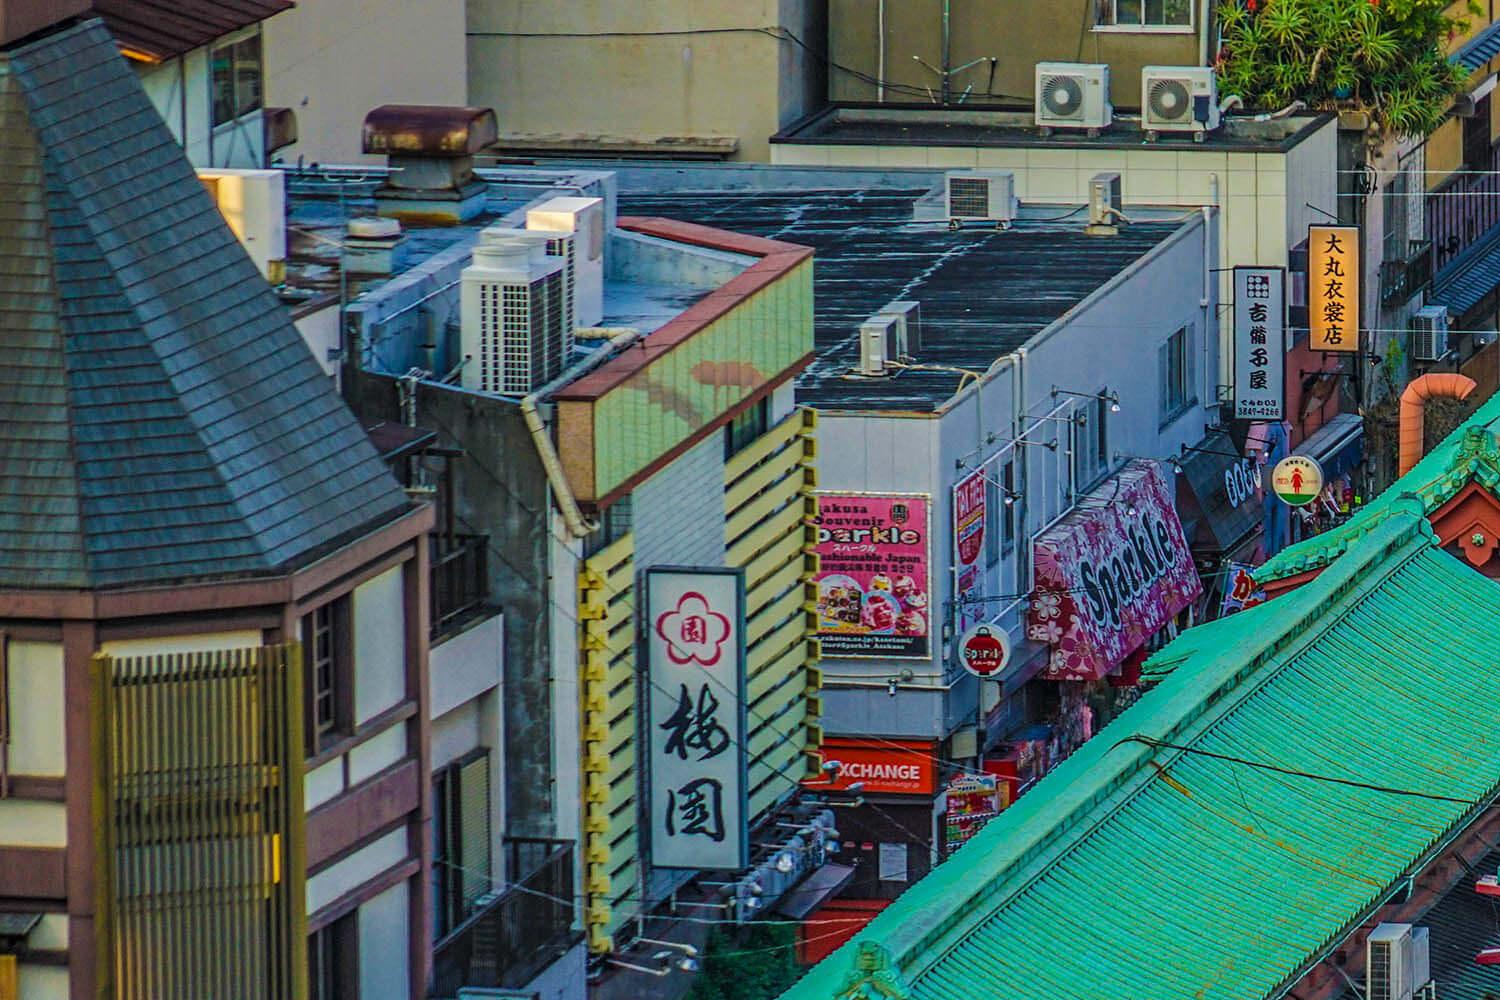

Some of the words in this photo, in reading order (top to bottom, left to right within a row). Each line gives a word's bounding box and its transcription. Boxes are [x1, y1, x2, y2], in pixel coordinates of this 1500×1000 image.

[1323, 233, 1345, 345] 大丸衣裳店
[822, 503, 868, 513] akusa
[1081, 511, 1176, 626] Sparkle
[681, 615, 706, 644] 園
[838, 763, 921, 780] XCHANGE
